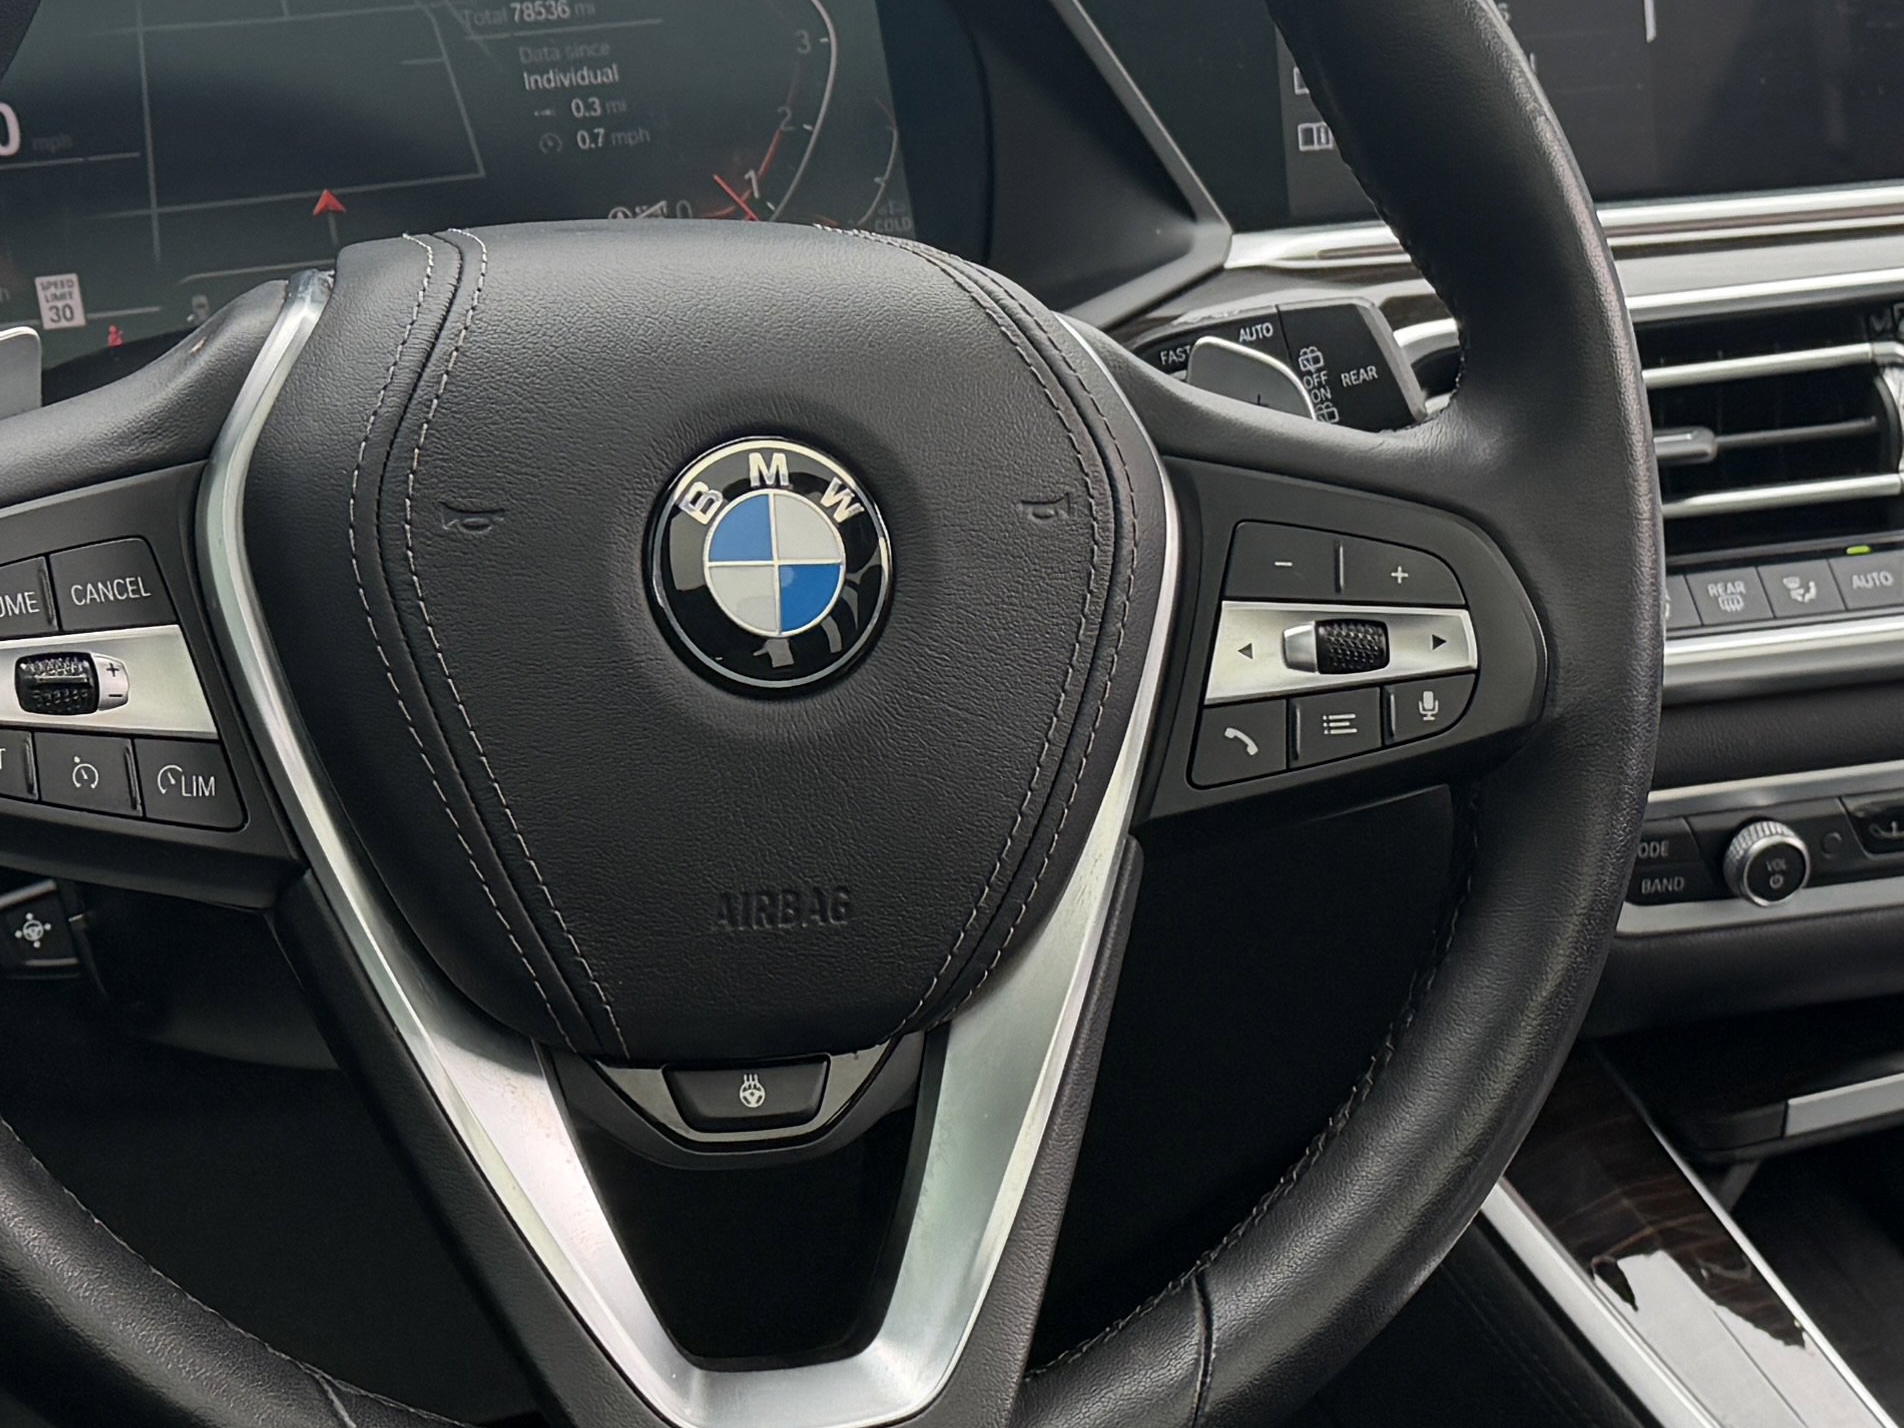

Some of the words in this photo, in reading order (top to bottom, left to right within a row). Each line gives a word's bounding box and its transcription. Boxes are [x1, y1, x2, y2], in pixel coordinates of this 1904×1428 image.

[510, 0, 571, 22] 78536
[519, 46, 561, 63] Data
[565, 42, 611, 59] since
[797, 31, 812, 54] 3
[523, 63, 620, 90] Individual
[571, 97, 602, 118] 0.3
[576, 128, 605, 149] 0.7
[744, 169, 760, 199] 1
[40, 278, 75, 291] SPEED
[45, 290, 74, 303] LIMIT
[49, 305, 75, 323] 30
[1238, 322, 1274, 343] AUTO
[1304, 371, 1329, 388] OFF
[1340, 365, 1378, 387] REAR
[1310, 386, 1332, 403] ON
[678, 452, 866, 525] BMW
[70, 575, 151, 606] CANCEL
[1707, 580, 1746, 598] REAR
[1851, 571, 1894, 589] AUTO
[181, 775, 216, 797] LIM
[1637, 840, 1670, 859] ODE
[1641, 875, 1685, 894] BAND
[714, 887, 852, 930] AIRBAG
